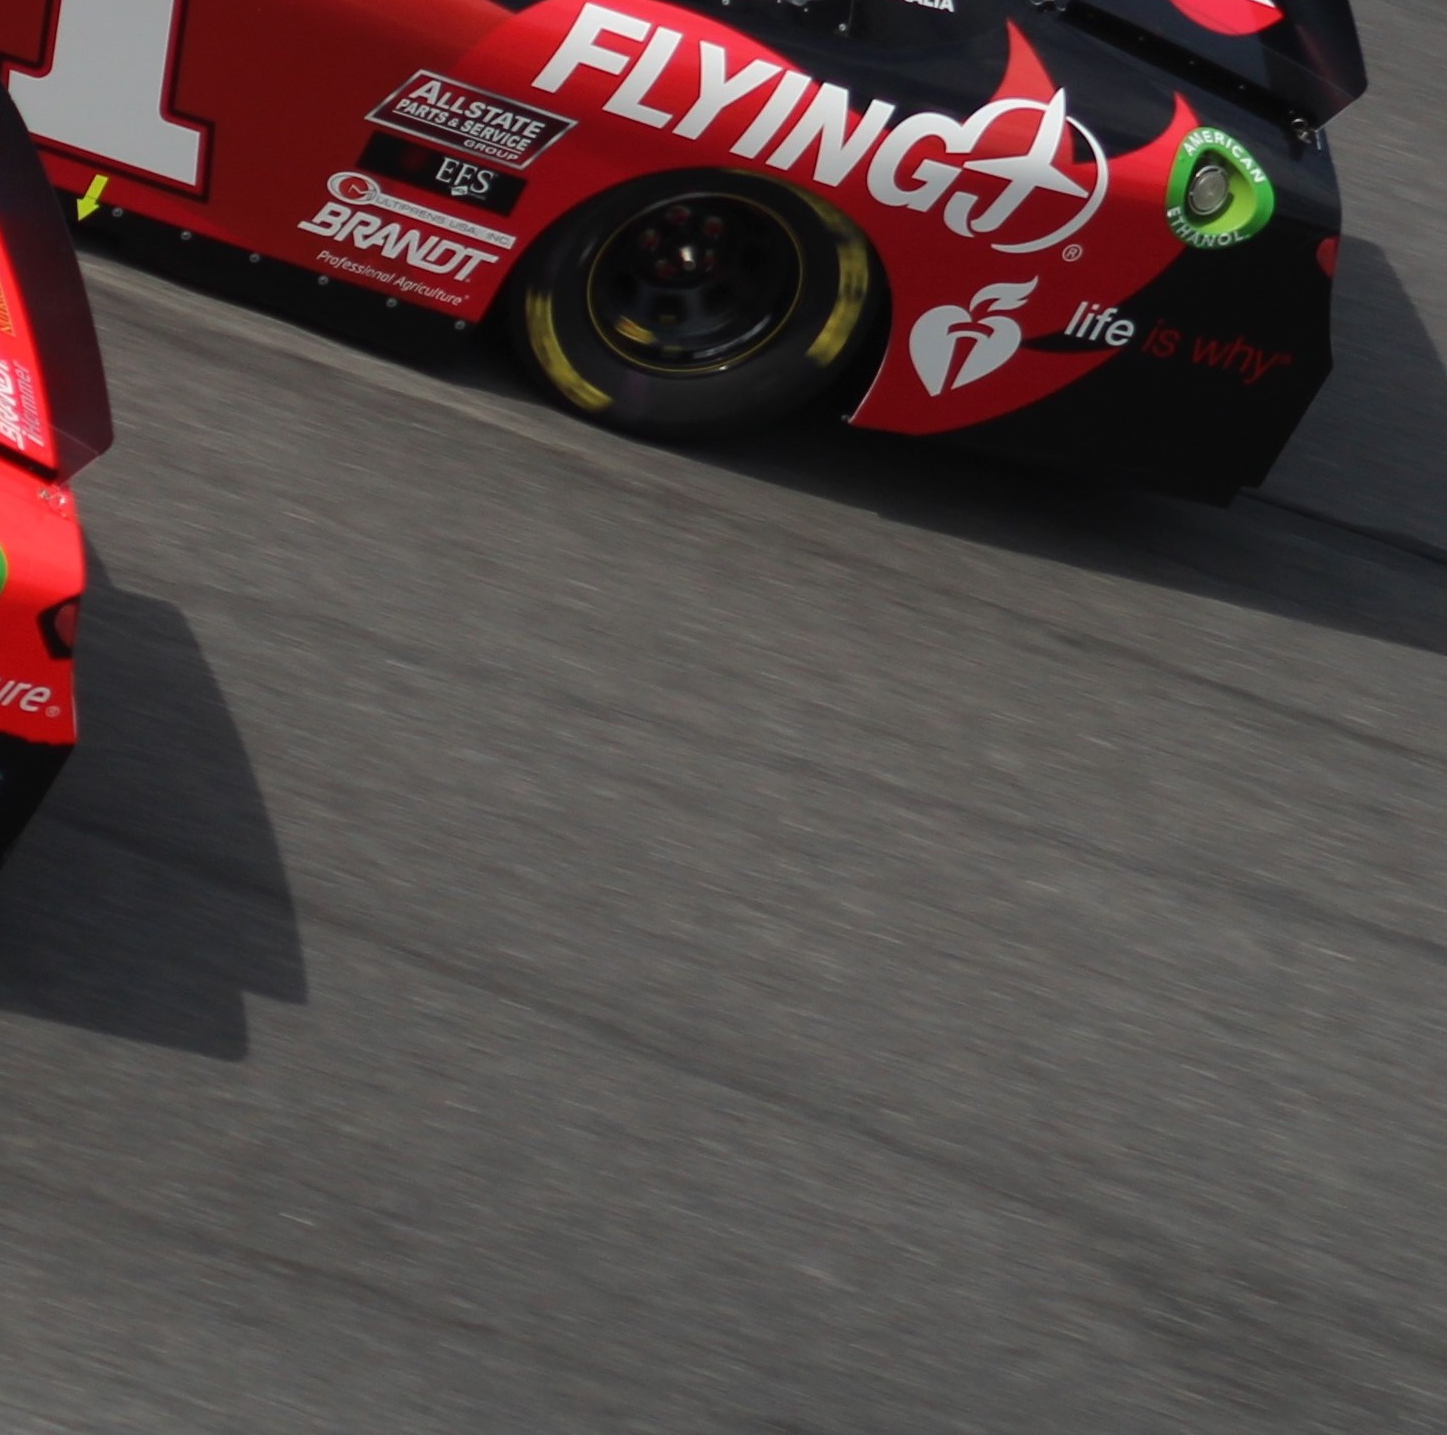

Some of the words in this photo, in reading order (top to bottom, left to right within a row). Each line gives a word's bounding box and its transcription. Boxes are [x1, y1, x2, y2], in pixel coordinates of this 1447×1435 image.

[395, 98, 449, 125] PARTS
[449, 118, 460, 129] &
[460, 120, 532, 152] SERVICE
[408, 80, 545, 139] ALLSTATE
[531, 3, 977, 214] FLYING
[435, 157, 494, 193] EFS
[463, 138, 519, 162] GROUP
[1183, 130, 1266, 183] AMERICAN
[297, 201, 500, 282] BRANDT
[1167, 207, 1244, 247] ETHANOL
[316, 250, 393, 283] Professional
[393, 275, 463, 307] Agriculture
[1064, 301, 1135, 346] life
[1141, 318, 1181, 358] is
